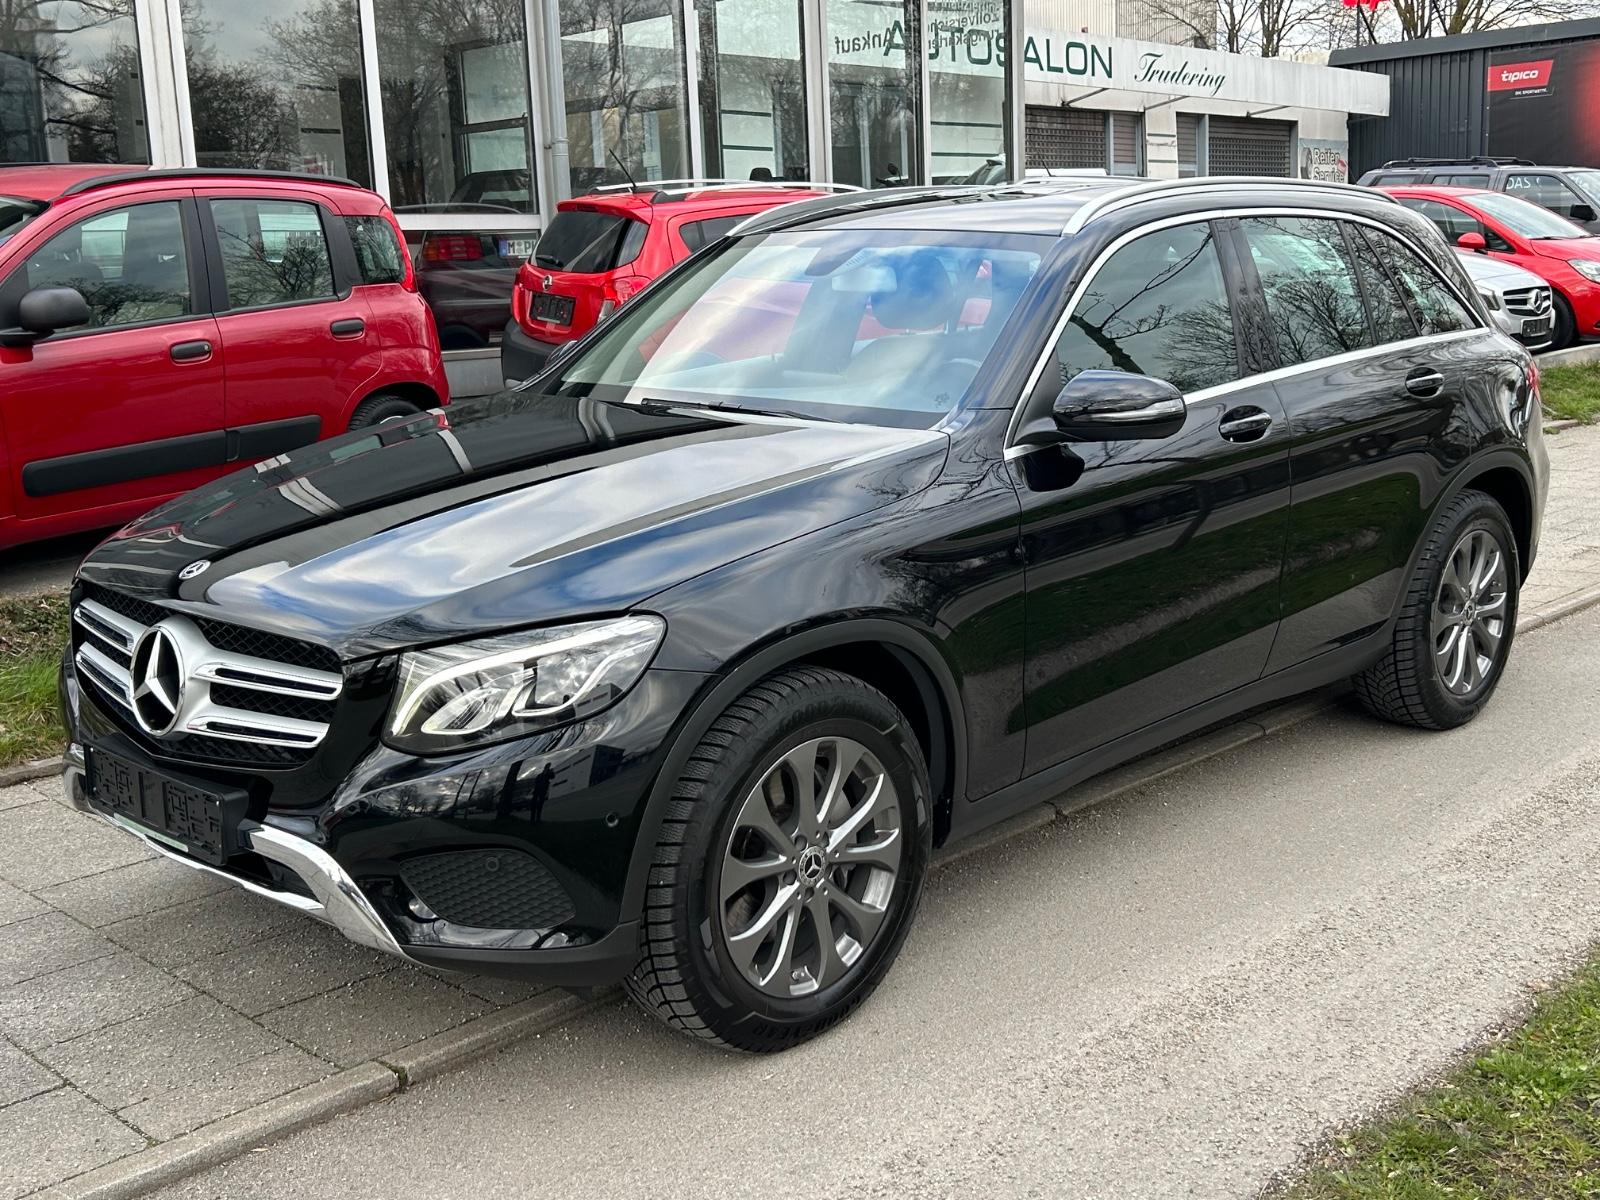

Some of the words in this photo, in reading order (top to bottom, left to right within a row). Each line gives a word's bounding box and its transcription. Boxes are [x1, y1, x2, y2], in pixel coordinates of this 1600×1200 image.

[1134, 52, 1230, 97] Trudering
[1501, 69, 1539, 83] tipico
[1313, 147, 1341, 165] Reifen
[1313, 166, 1345, 183] Service
